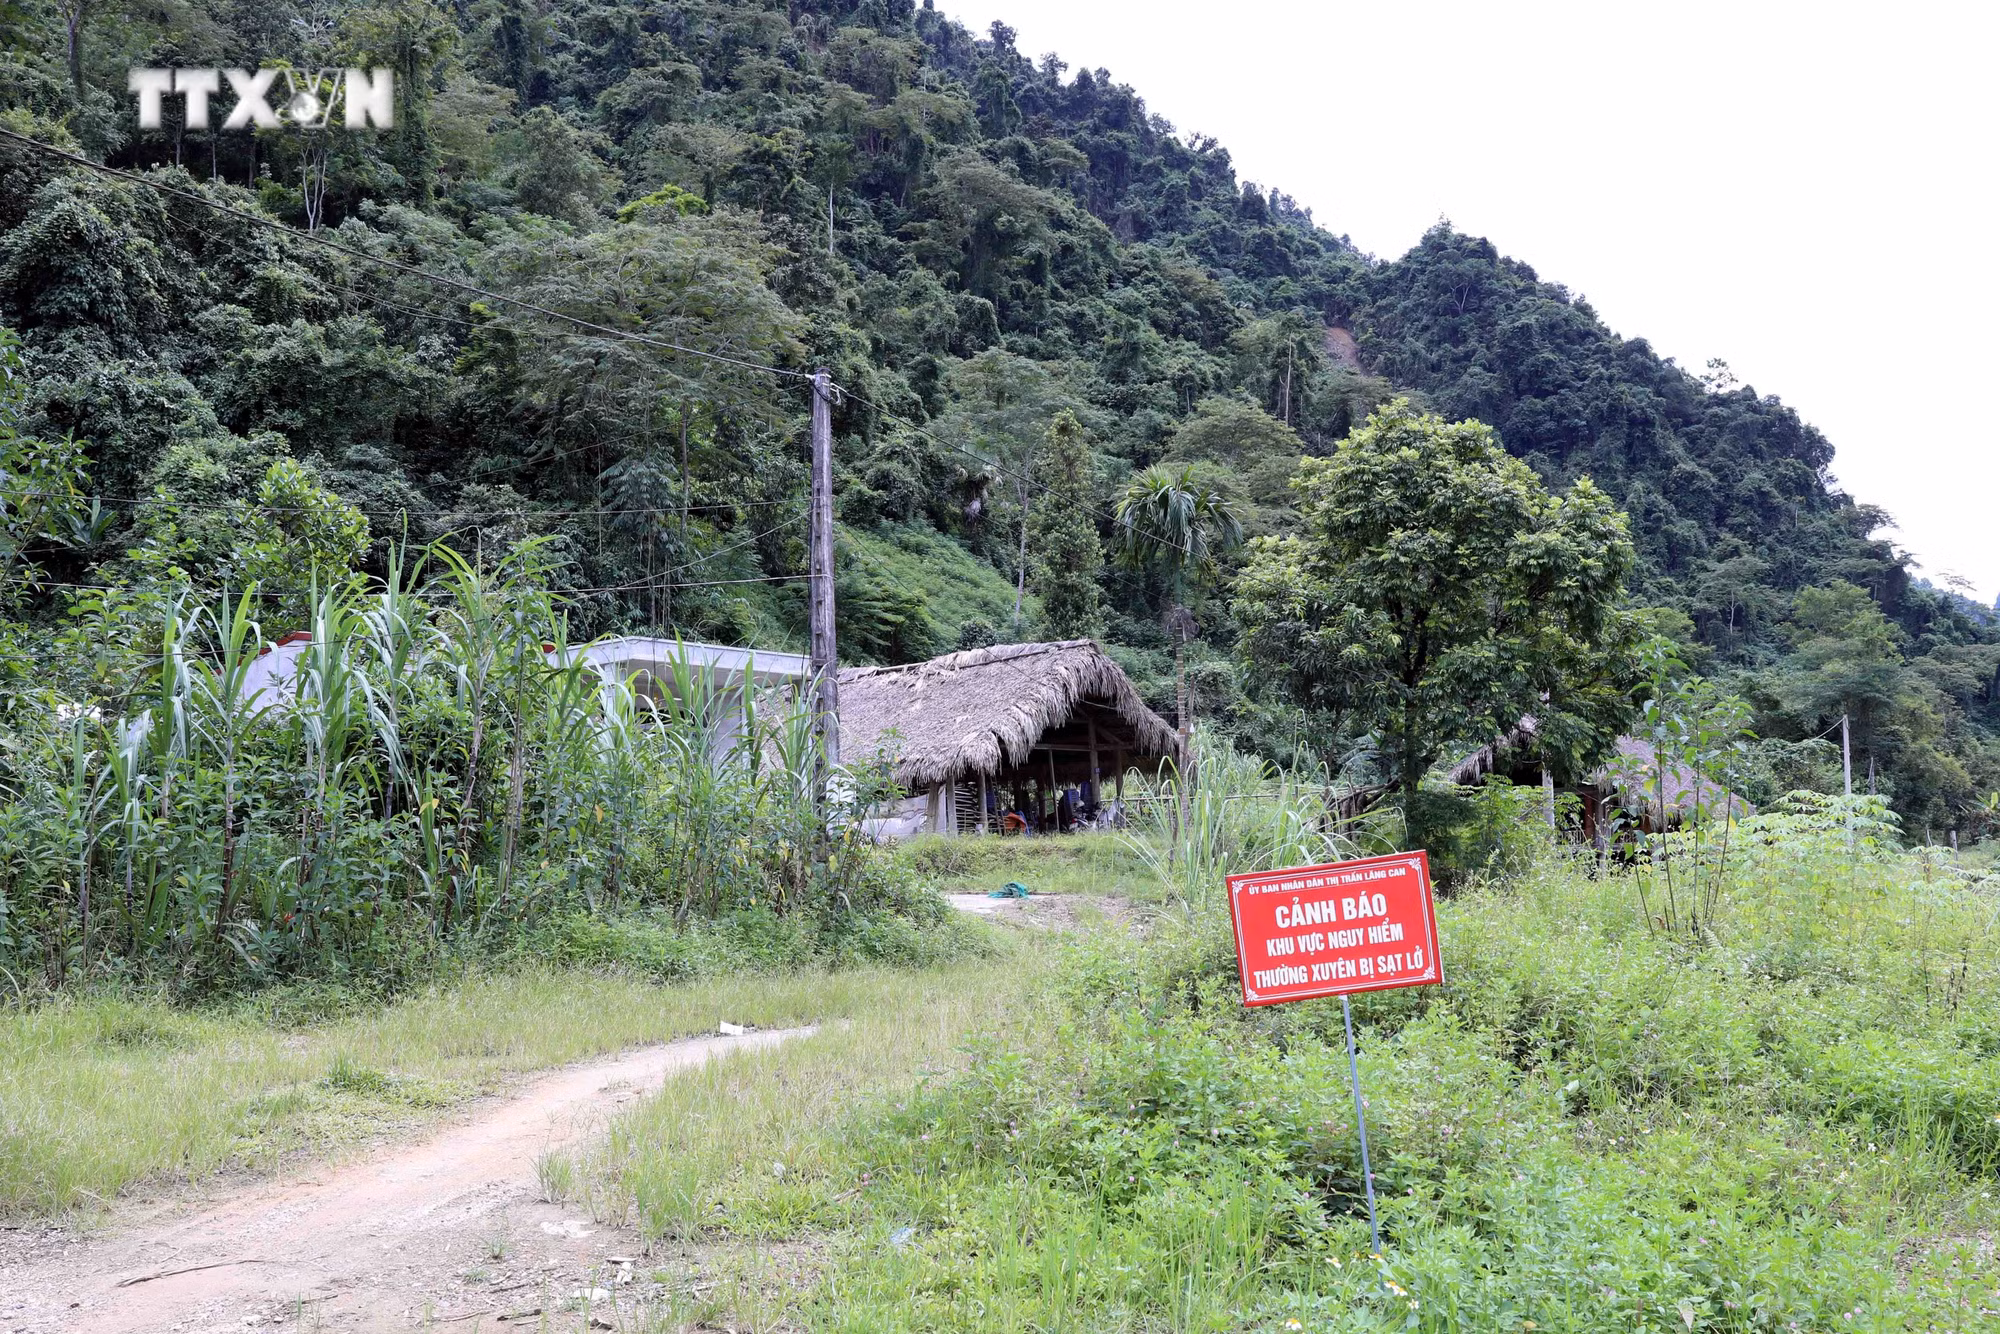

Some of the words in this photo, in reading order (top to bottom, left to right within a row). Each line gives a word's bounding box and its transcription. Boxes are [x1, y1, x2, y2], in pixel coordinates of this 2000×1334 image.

[1261, 883, 1280, 894] BAN
[1281, 879, 1305, 891] NHÂN
[1306, 877, 1325, 889] DÂN
[1325, 876, 1339, 887] THỊ
[1340, 871, 1363, 884] TRẤN
[1388, 867, 1406, 878] CAN
[1275, 897, 1336, 929] CẢNH
[1341, 890, 1387, 921] BÁO
[1265, 937, 1295, 957] KHU
[1296, 931, 1325, 956] VỰC
[1327, 928, 1364, 950] NGUY
[1367, 917, 1404, 945] HIỂM
[1253, 962, 1308, 988] THƯỜNG
[1310, 957, 1356, 982] XUYÊN
[1359, 957, 1374, 979] BỊ
[1376, 953, 1403, 976] SẠT
[1405, 944, 1424, 970] LỞ
